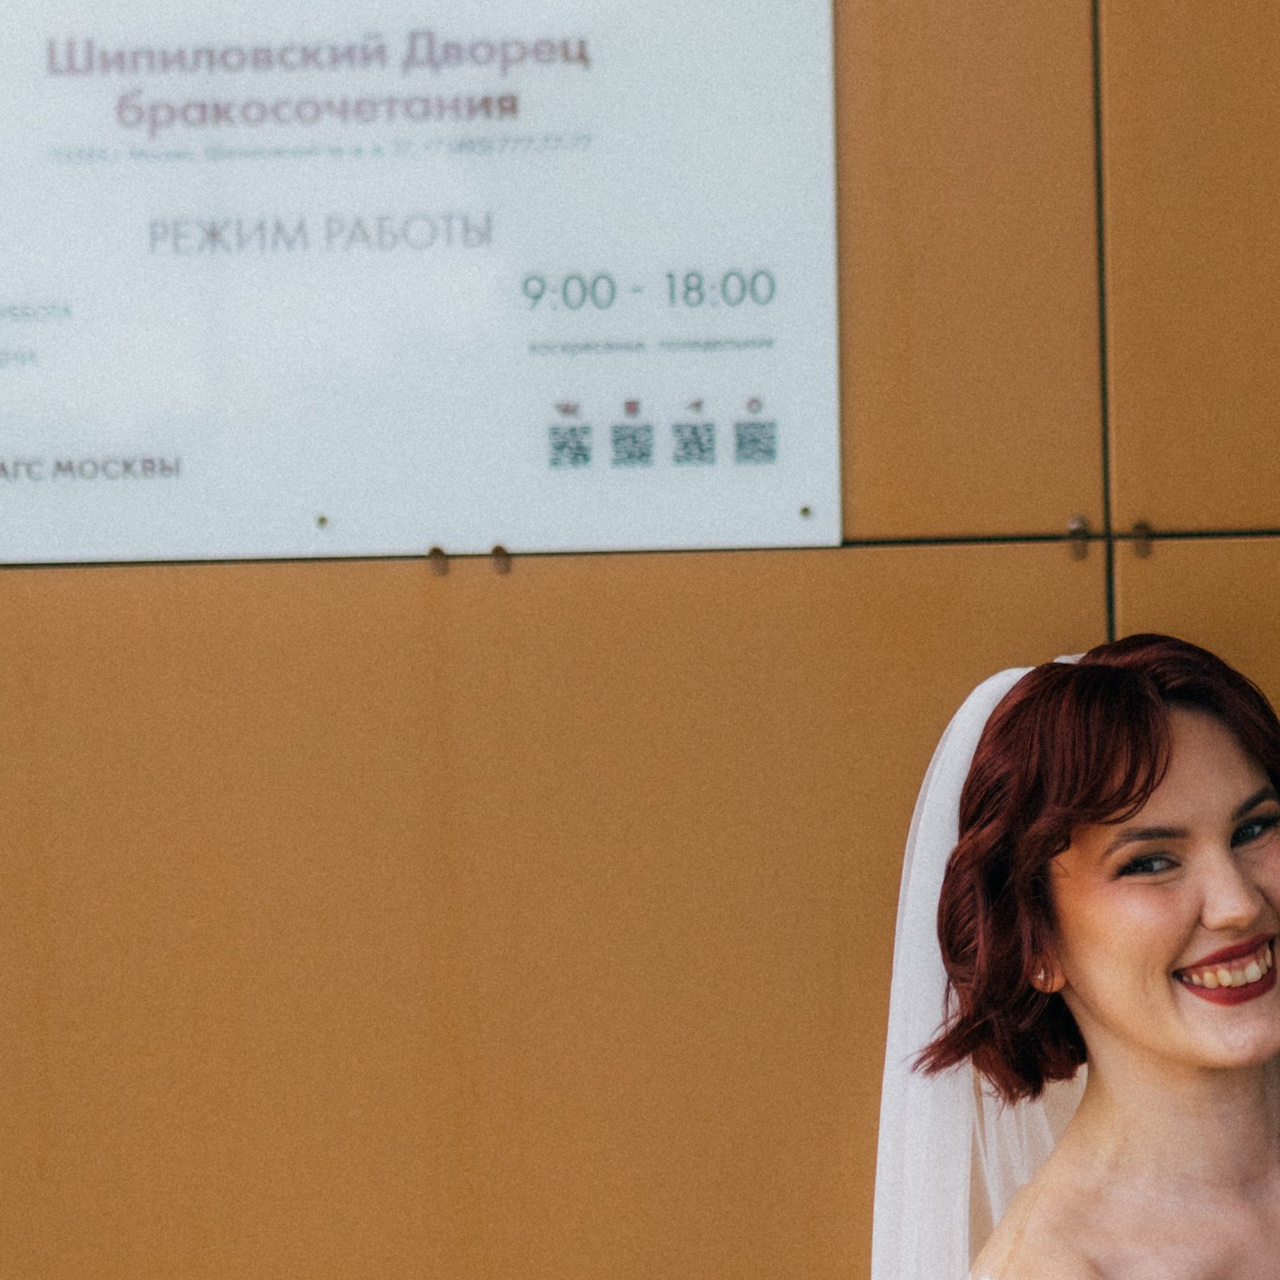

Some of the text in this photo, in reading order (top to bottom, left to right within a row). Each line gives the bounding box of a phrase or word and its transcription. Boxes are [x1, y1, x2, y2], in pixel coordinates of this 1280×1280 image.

[45, 28, 592, 76] Шипиловский Дворец
[116, 88, 520, 138] бракосочетания
[148, 211, 494, 255] РЕЖИМ РАБОТЫ
[522, 274, 617, 311] 9:00
[664, 270, 777, 307] 18:00
[53, 457, 183, 480] МОСКВЫ
